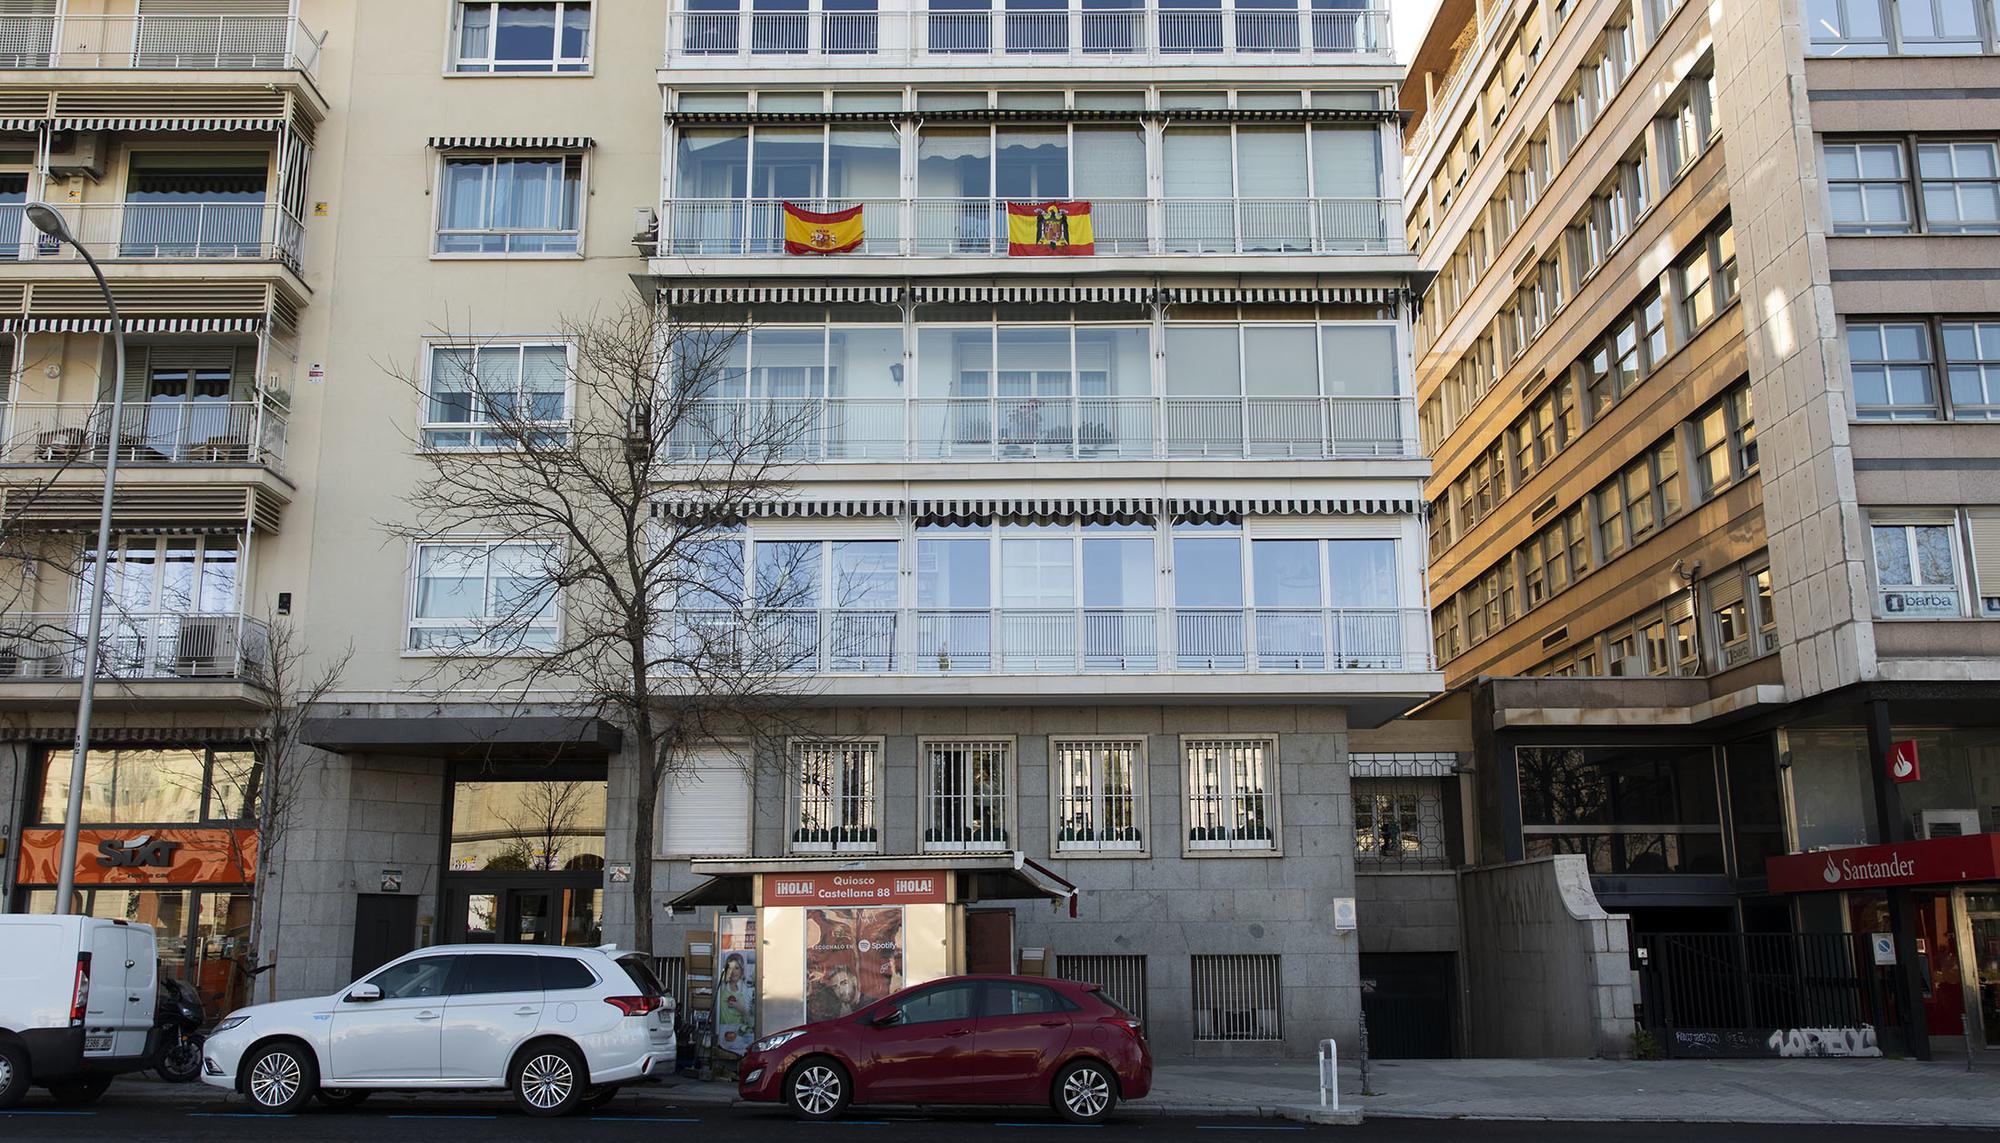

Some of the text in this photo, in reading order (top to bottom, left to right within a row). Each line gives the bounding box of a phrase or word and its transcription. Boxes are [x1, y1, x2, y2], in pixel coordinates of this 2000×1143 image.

[1905, 594, 1952, 607] barba
[1842, 852, 1914, 880] Santander
[833, 876, 875, 886] Quiosco
[896, 879, 932, 893] ¡HOLA!
[777, 882, 813, 895] ¡HOLA!
[818, 888, 891, 898] Castellana 88
[872, 941, 897, 950] Spotify
